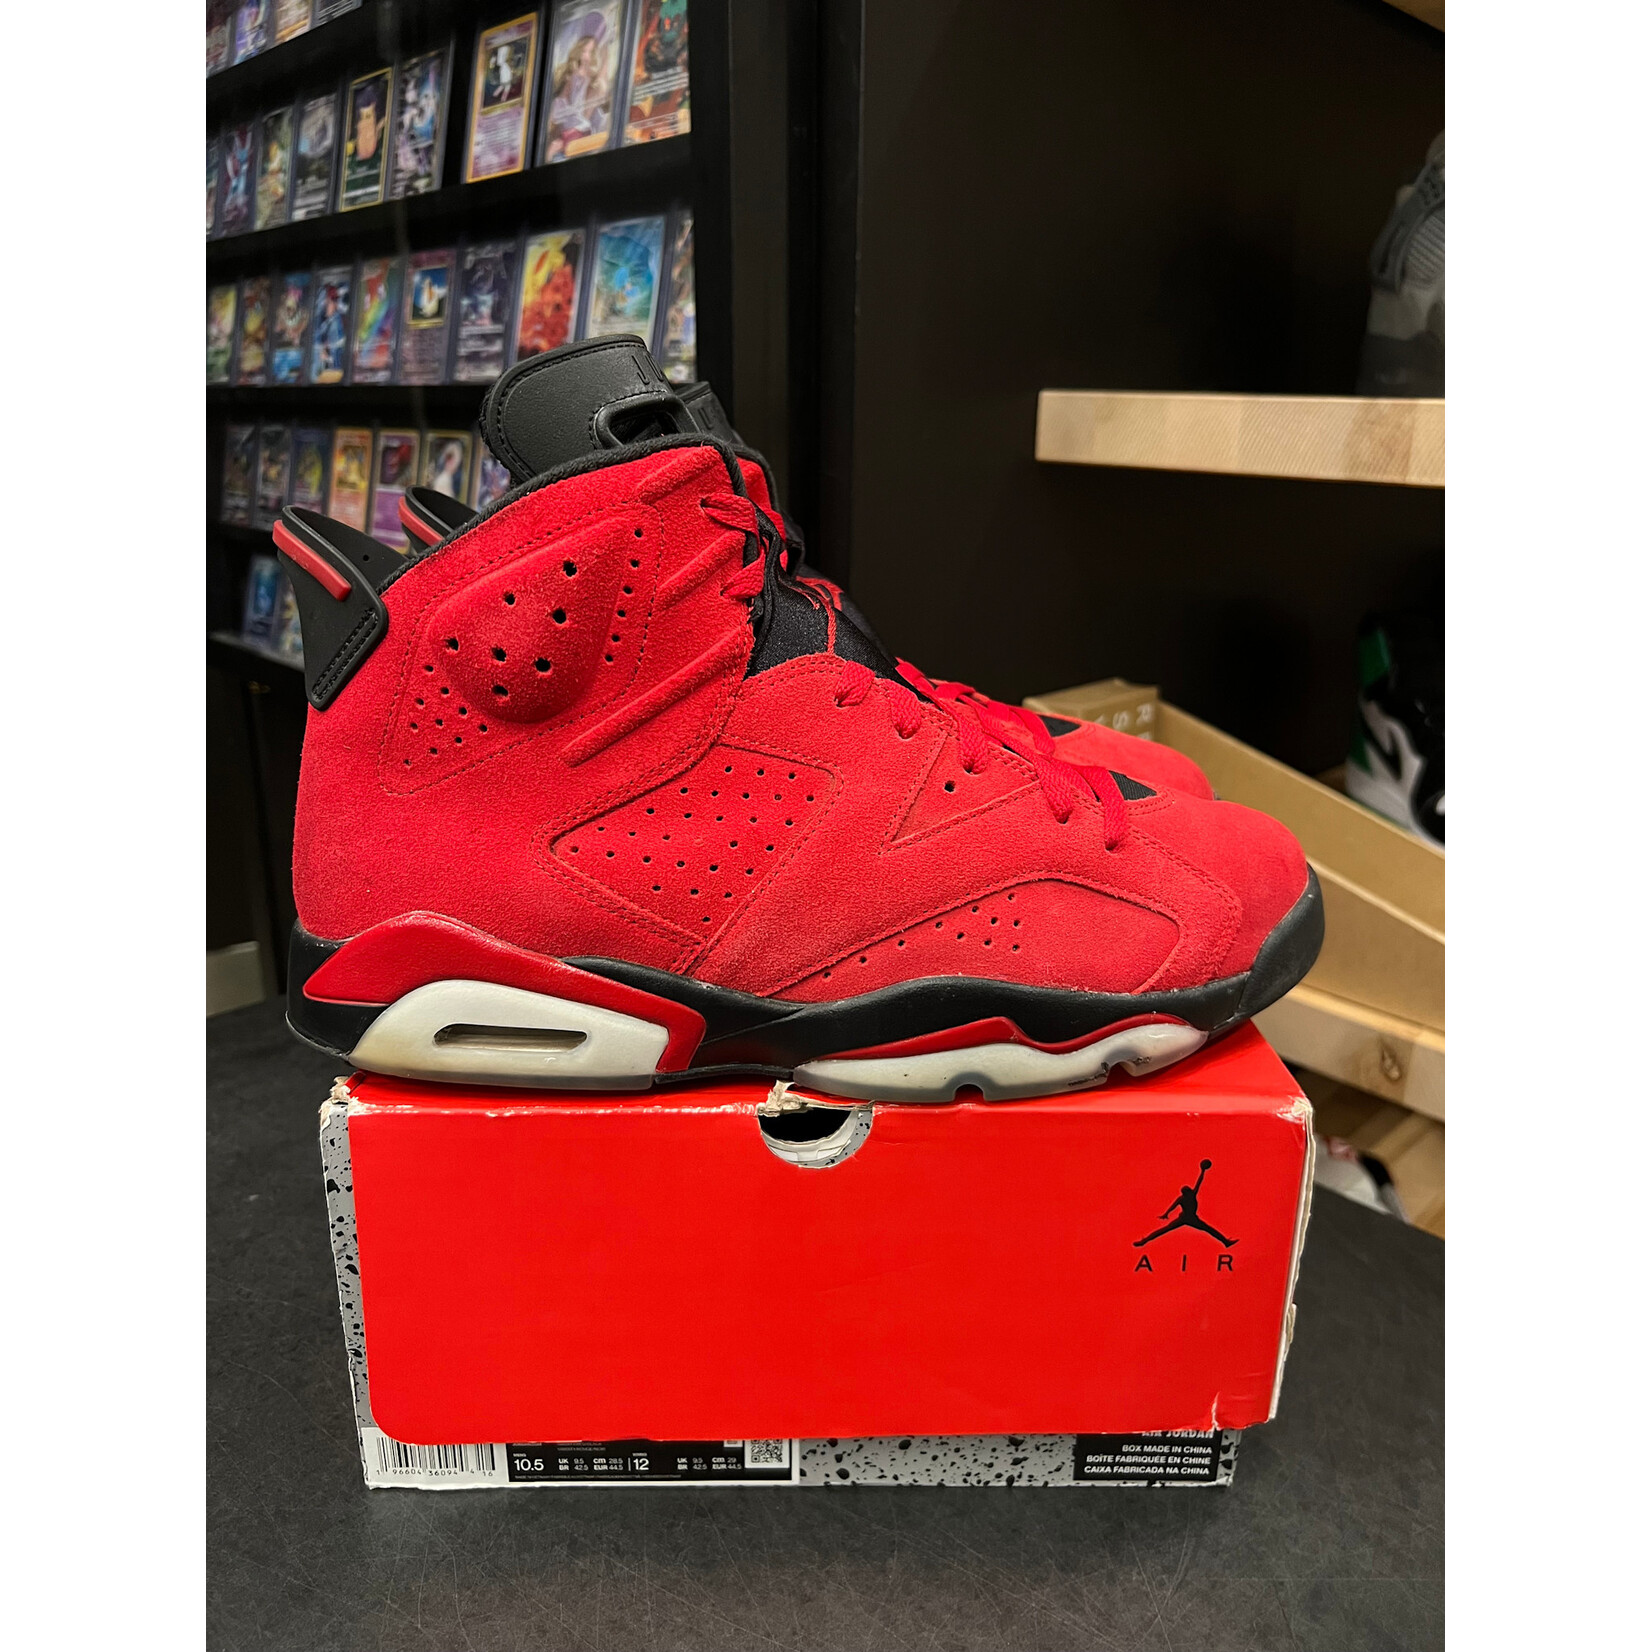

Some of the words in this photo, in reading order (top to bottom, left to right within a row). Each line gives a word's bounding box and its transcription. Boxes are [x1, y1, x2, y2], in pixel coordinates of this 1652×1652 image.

[1134, 1254, 1233, 1272] AIR
[1122, 1444, 1142, 1453] BOX
[1143, 1445, 1170, 1453] MADE
[1171, 1445, 1182, 1453] IN
[1183, 1445, 1213, 1454] CHINA
[513, 1458, 545, 1471] 10.5
[633, 1458, 649, 1471] 12
[1115, 1454, 1166, 1464] FABRIQUÉE
[1167, 1456, 1181, 1464] EN
[1182, 1456, 1211, 1465] CHINE
[1084, 1465, 1112, 1474] CAIXA
[1113, 1465, 1165, 1474] FABRICADA
[1165, 1466, 1180, 1474] NA
[1180, 1466, 1210, 1475] CHINA
